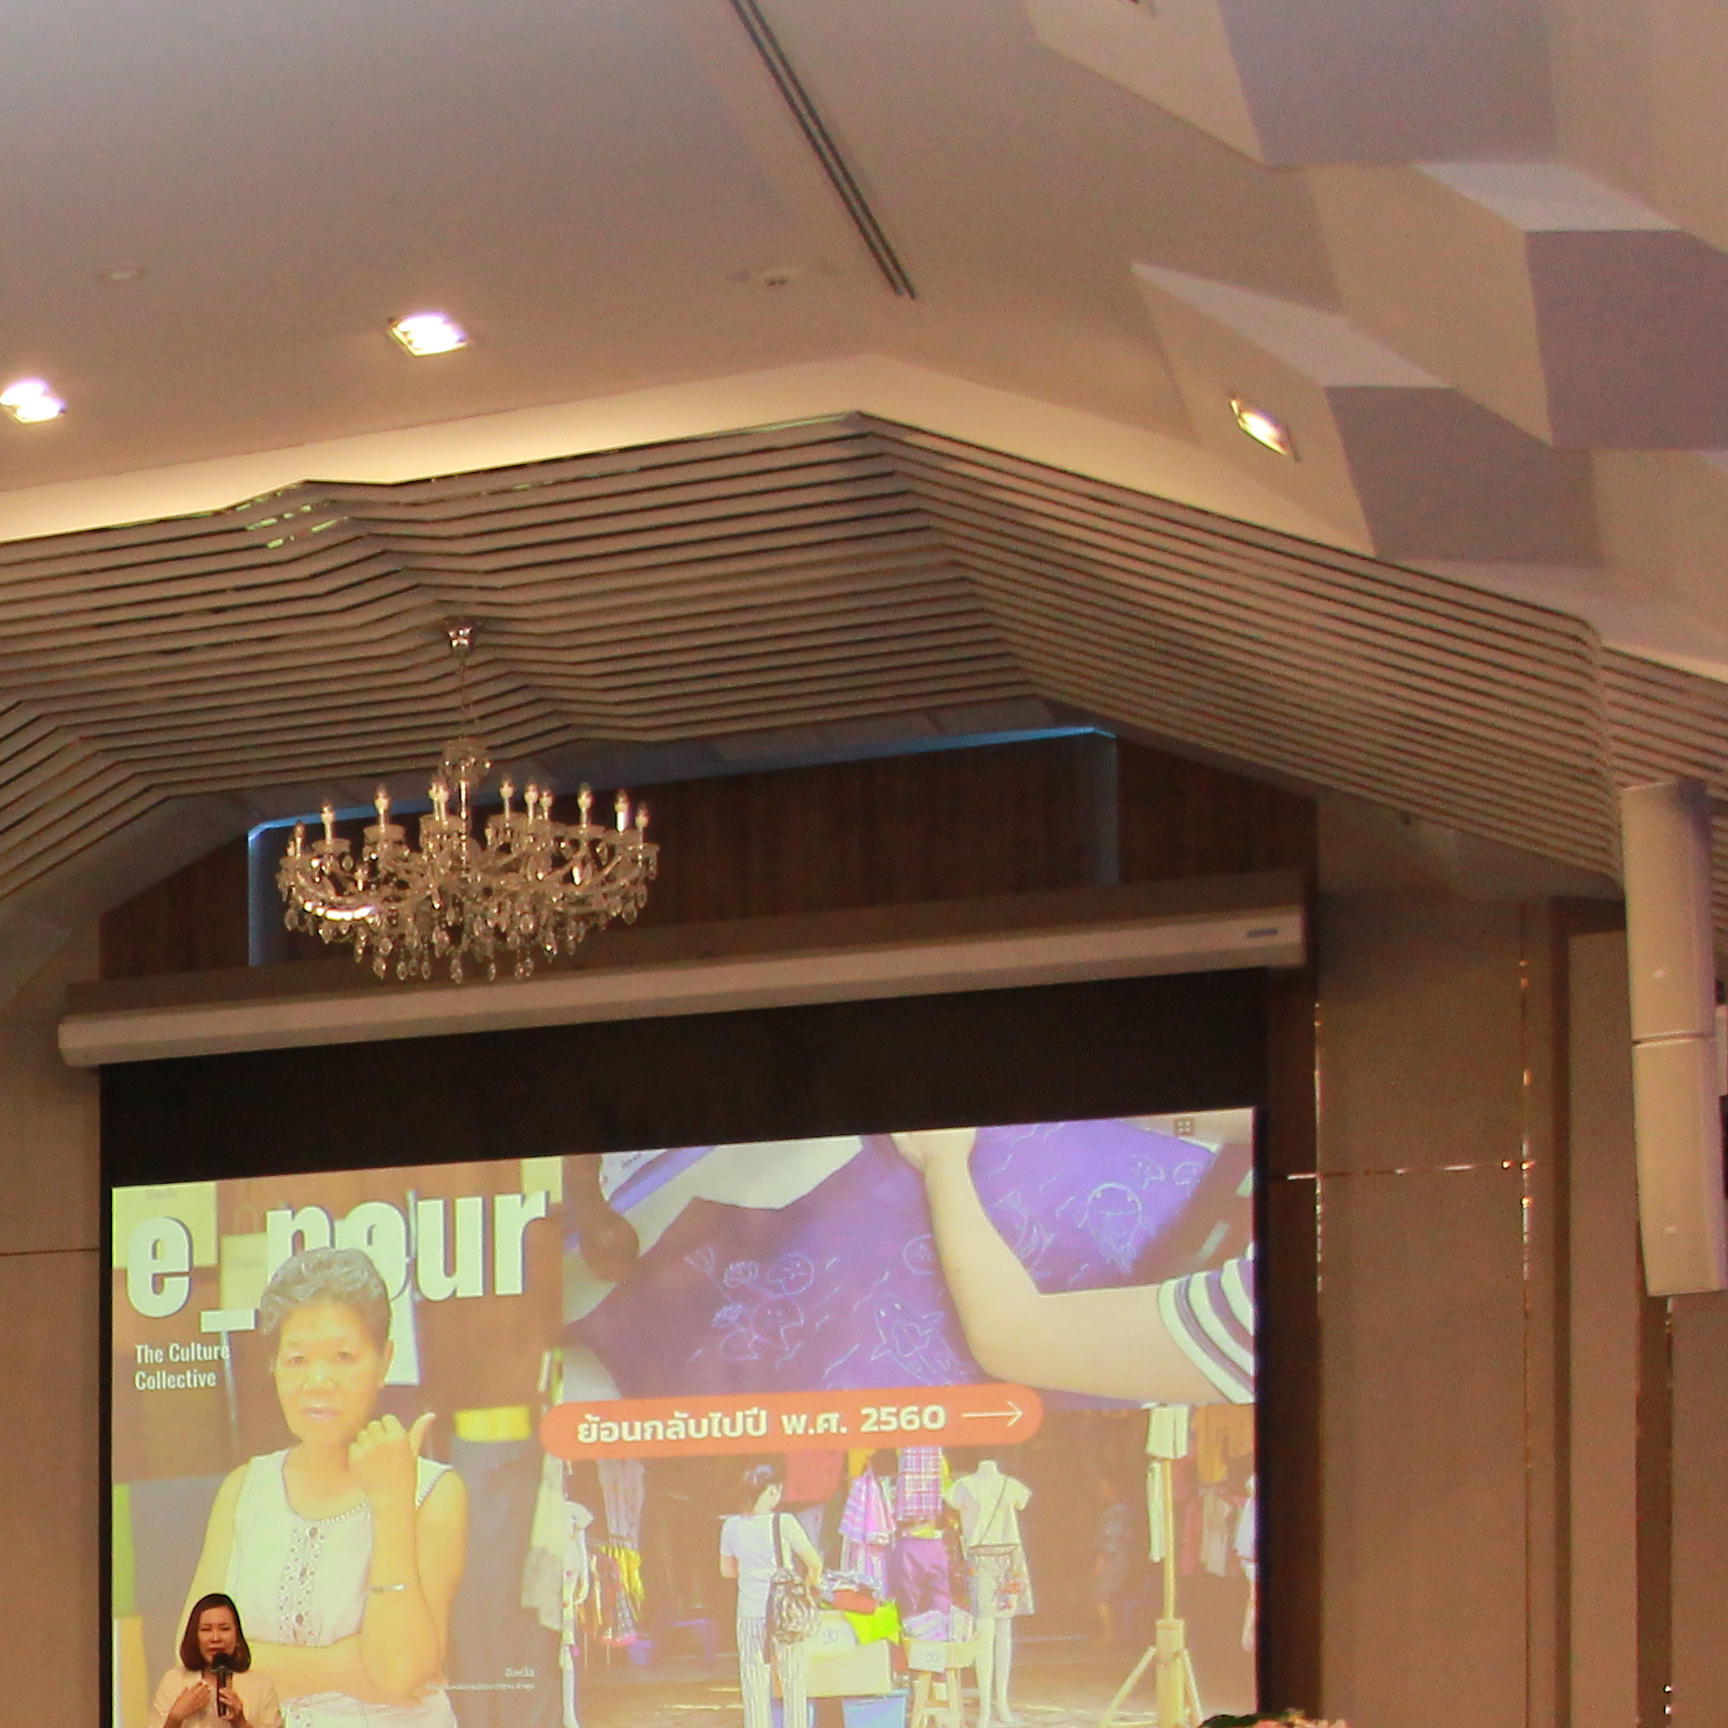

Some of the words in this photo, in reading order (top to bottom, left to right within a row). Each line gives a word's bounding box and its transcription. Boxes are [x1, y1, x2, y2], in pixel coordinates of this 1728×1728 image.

[134, 1343, 164, 1364] The
[169, 1341, 230, 1362] Culture
[134, 1370, 217, 1391] Collective
[577, 1408, 768, 1444] ย้อนกลับไปปี
[781, 1411, 848, 1436] พ.ศ.
[861, 1405, 945, 1433] 2560
